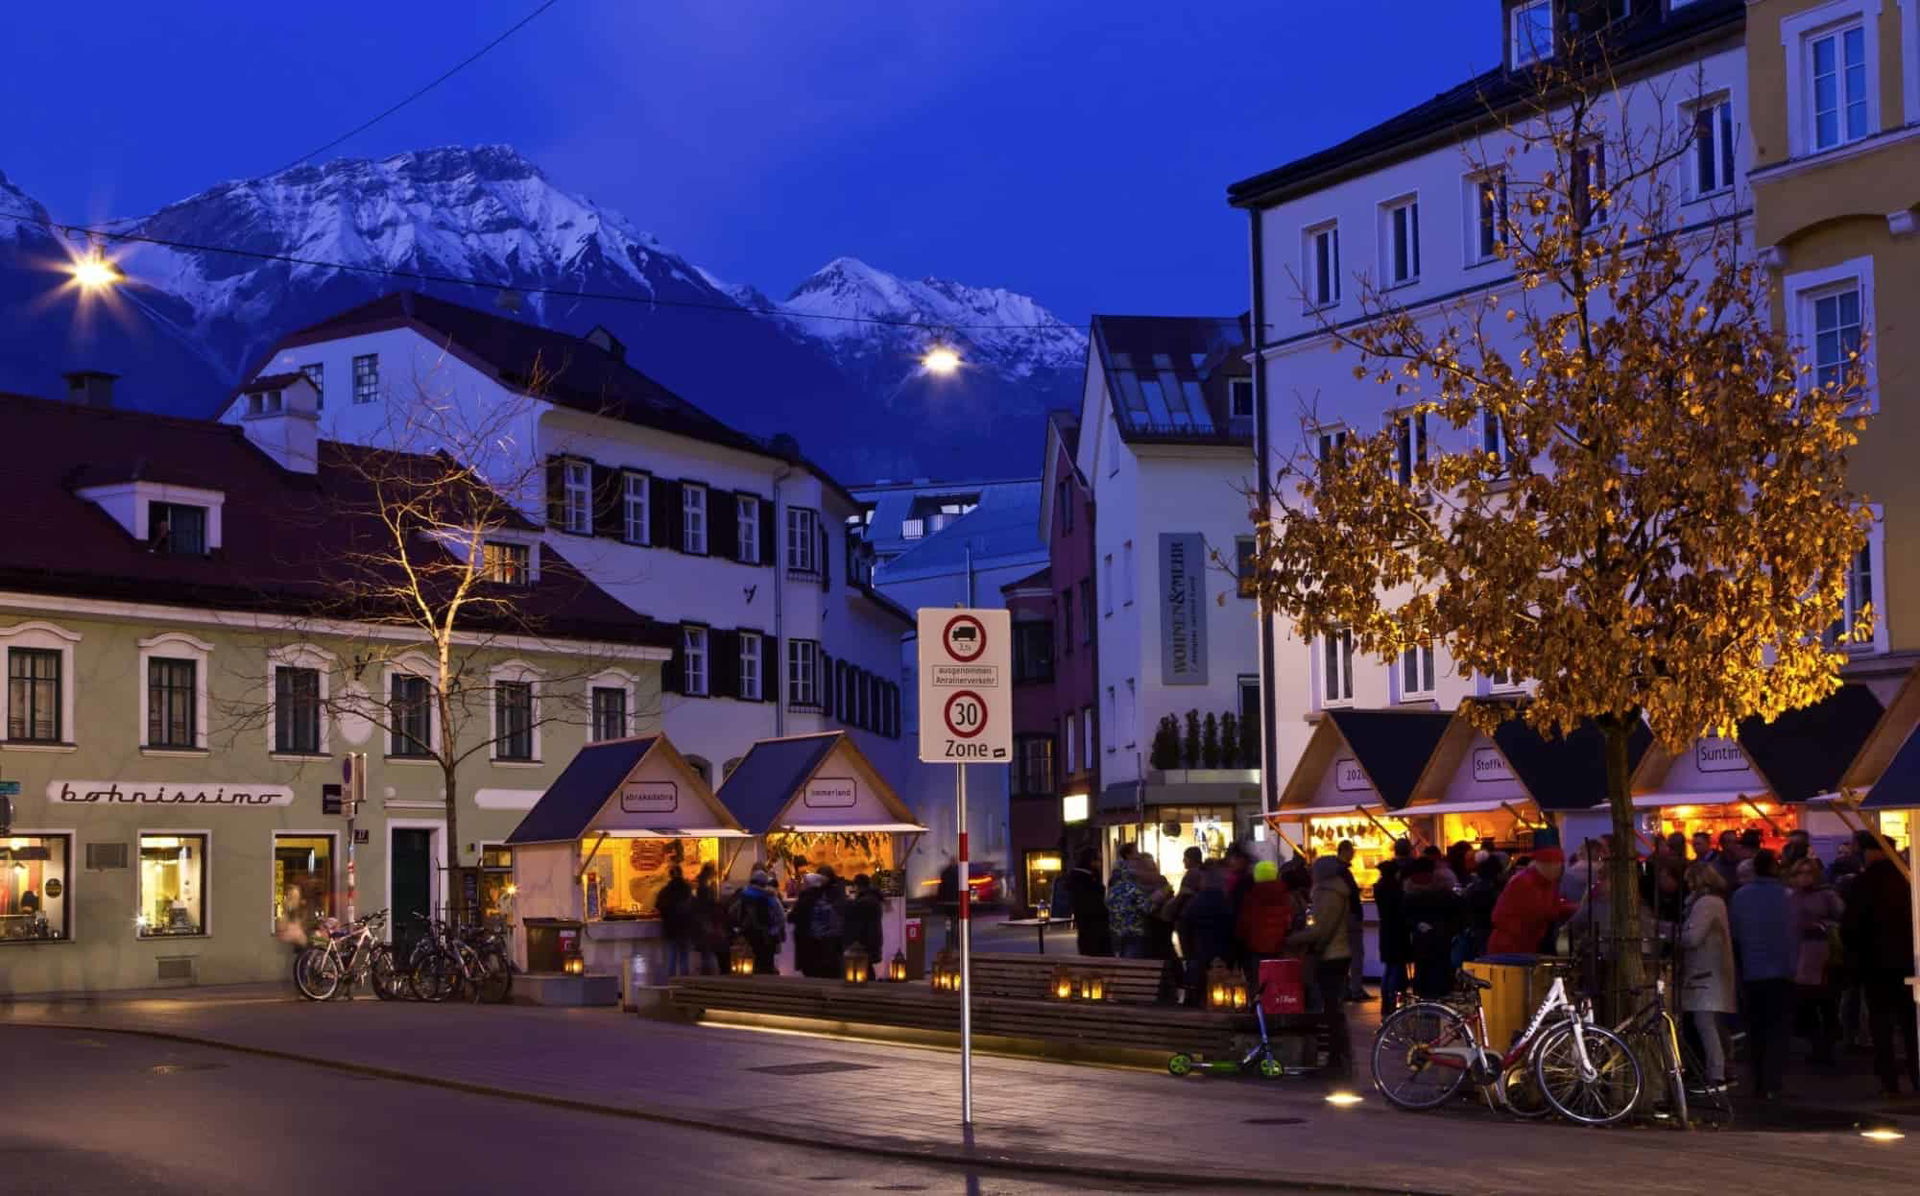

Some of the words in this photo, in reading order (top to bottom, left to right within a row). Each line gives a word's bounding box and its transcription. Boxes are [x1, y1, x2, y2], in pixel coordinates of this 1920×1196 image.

[955, 702, 978, 726] 30
[945, 740, 988, 757] Zone
[61, 783, 282, 804] bohnissimo
